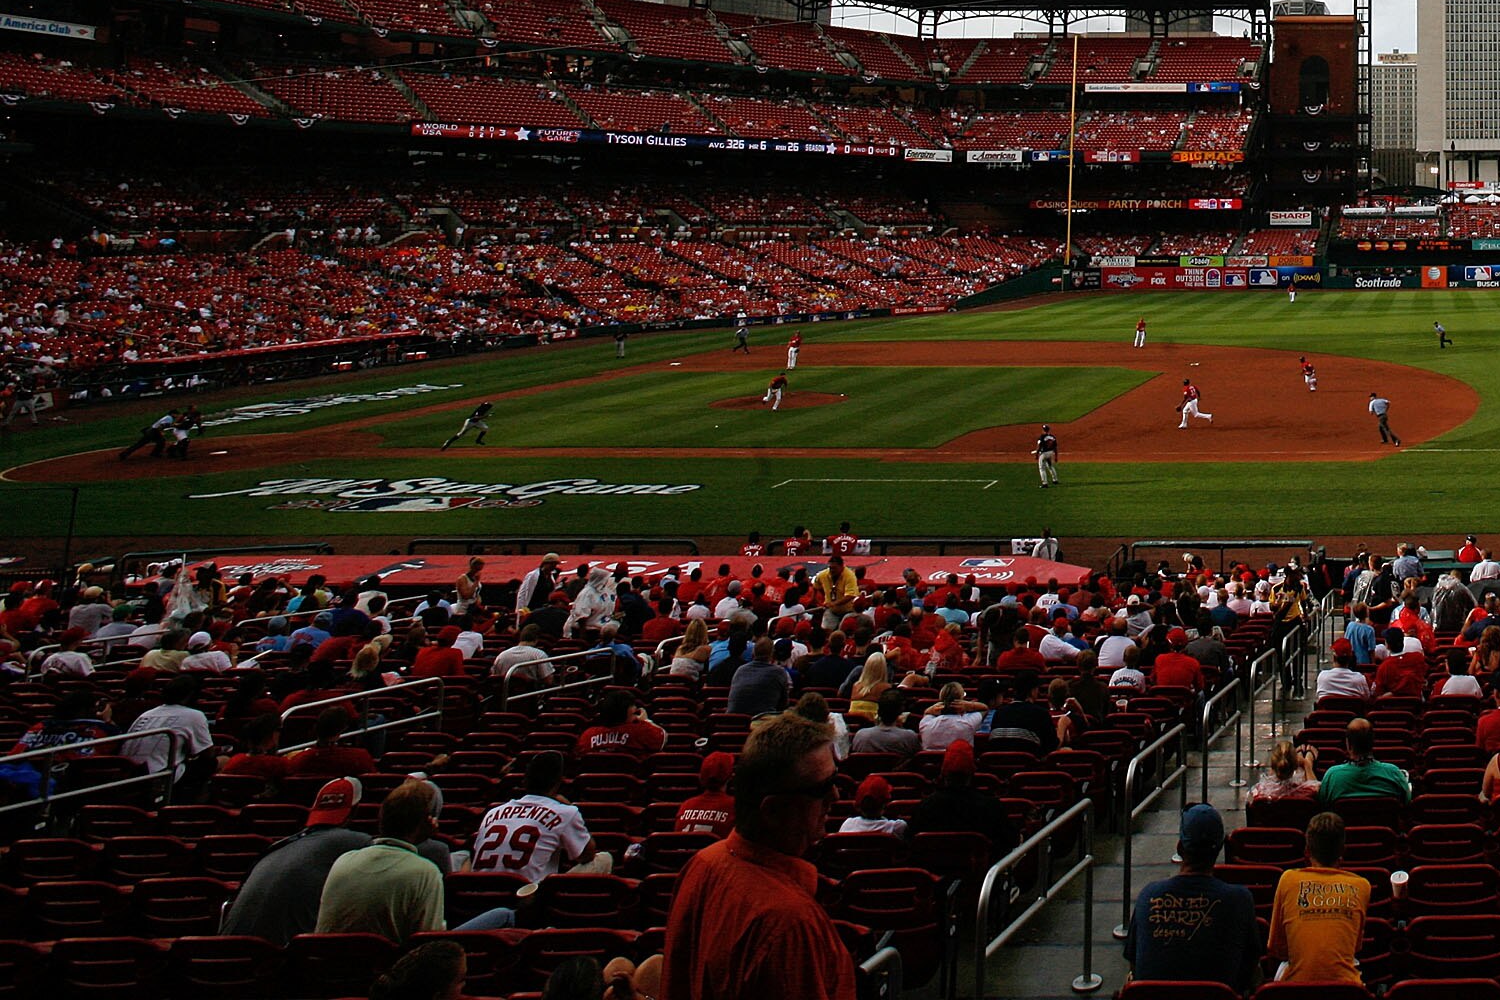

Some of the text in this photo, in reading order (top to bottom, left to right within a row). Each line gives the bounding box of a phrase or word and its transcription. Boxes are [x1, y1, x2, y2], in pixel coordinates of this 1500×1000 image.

[4, 18, 71, 34] America Club
[606, 133, 799, 152] TYSON GILLIES 326 26
[906, 151, 936, 160] Energizer
[972, 151, 1017, 161] American
[1180, 152, 1235, 163] BIG MAC
[1036, 200, 1067, 209] CASINO
[1108, 200, 1141, 209] PARTY
[1146, 200, 1182, 209] PORCH
[1151, 277, 1166, 285] FOX
[1355, 277, 1402, 288] Scottrade
[505, 478, 703, 499] Game
[590, 732, 629, 748] PUJOLS
[485, 806, 562, 831] CARPENTER
[680, 809, 728, 822] JUERGENS
[474, 824, 541, 870] 29
[1149, 908, 1206, 926] HARDY
